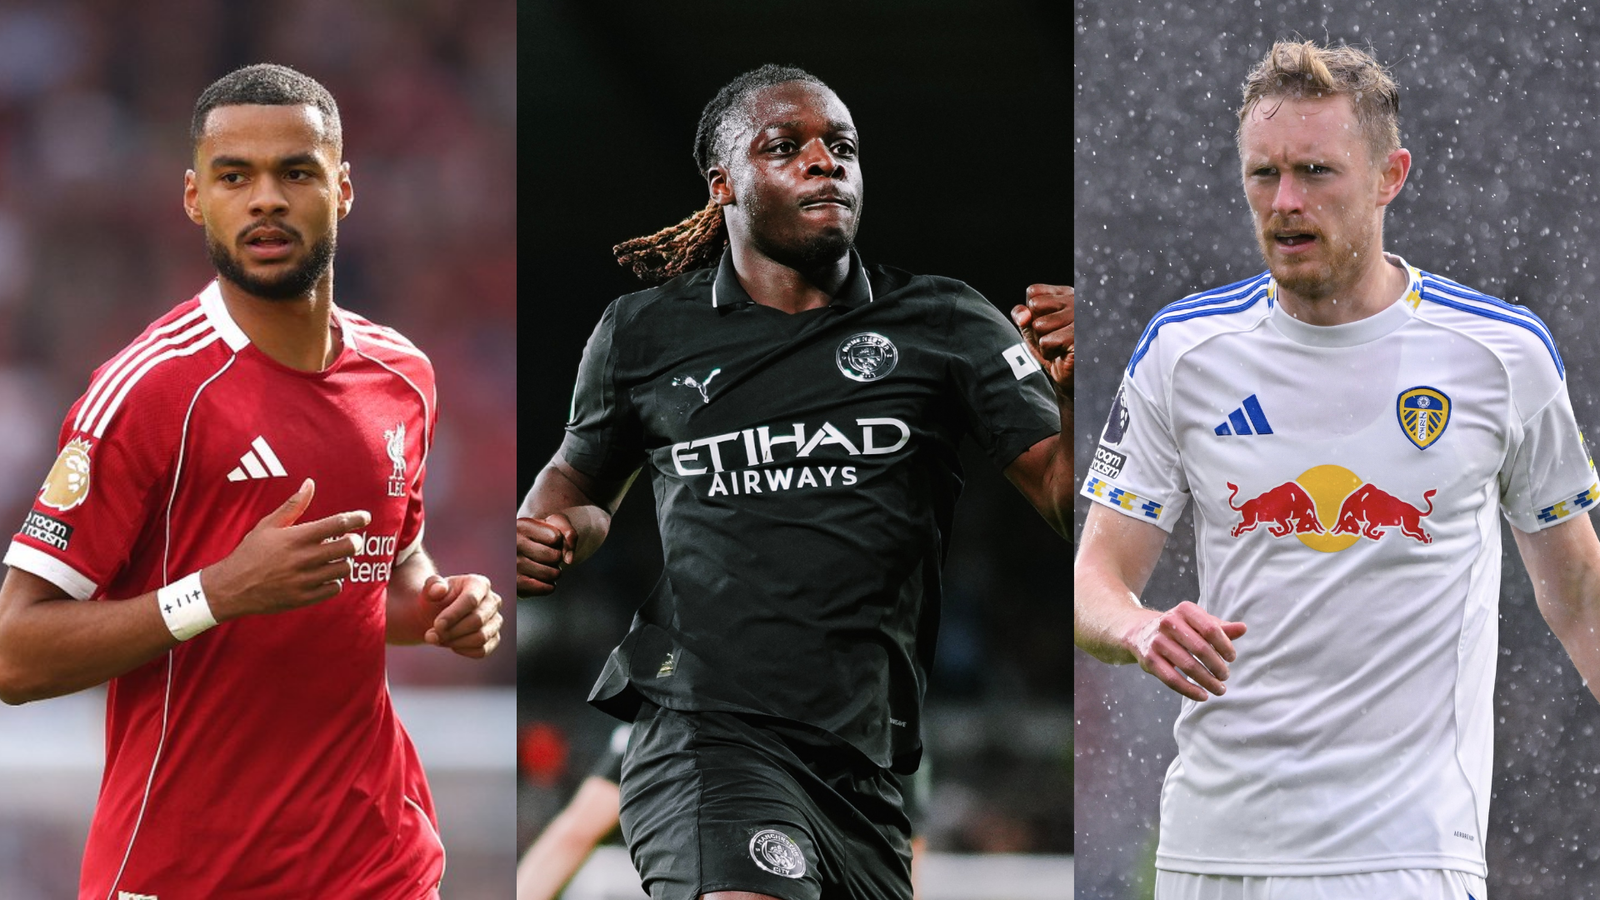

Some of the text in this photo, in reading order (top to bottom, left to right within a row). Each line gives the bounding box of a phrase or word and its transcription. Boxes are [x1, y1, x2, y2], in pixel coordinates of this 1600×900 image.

[671, 417, 910, 476] ETIHAD
[1095, 448, 1121, 467] room
[1090, 459, 1120, 478] racism
[708, 466, 857, 496] AIRWAYS
[31, 514, 67, 537] room
[25, 525, 68, 550] racism
[773, 866, 790, 875] CITY
